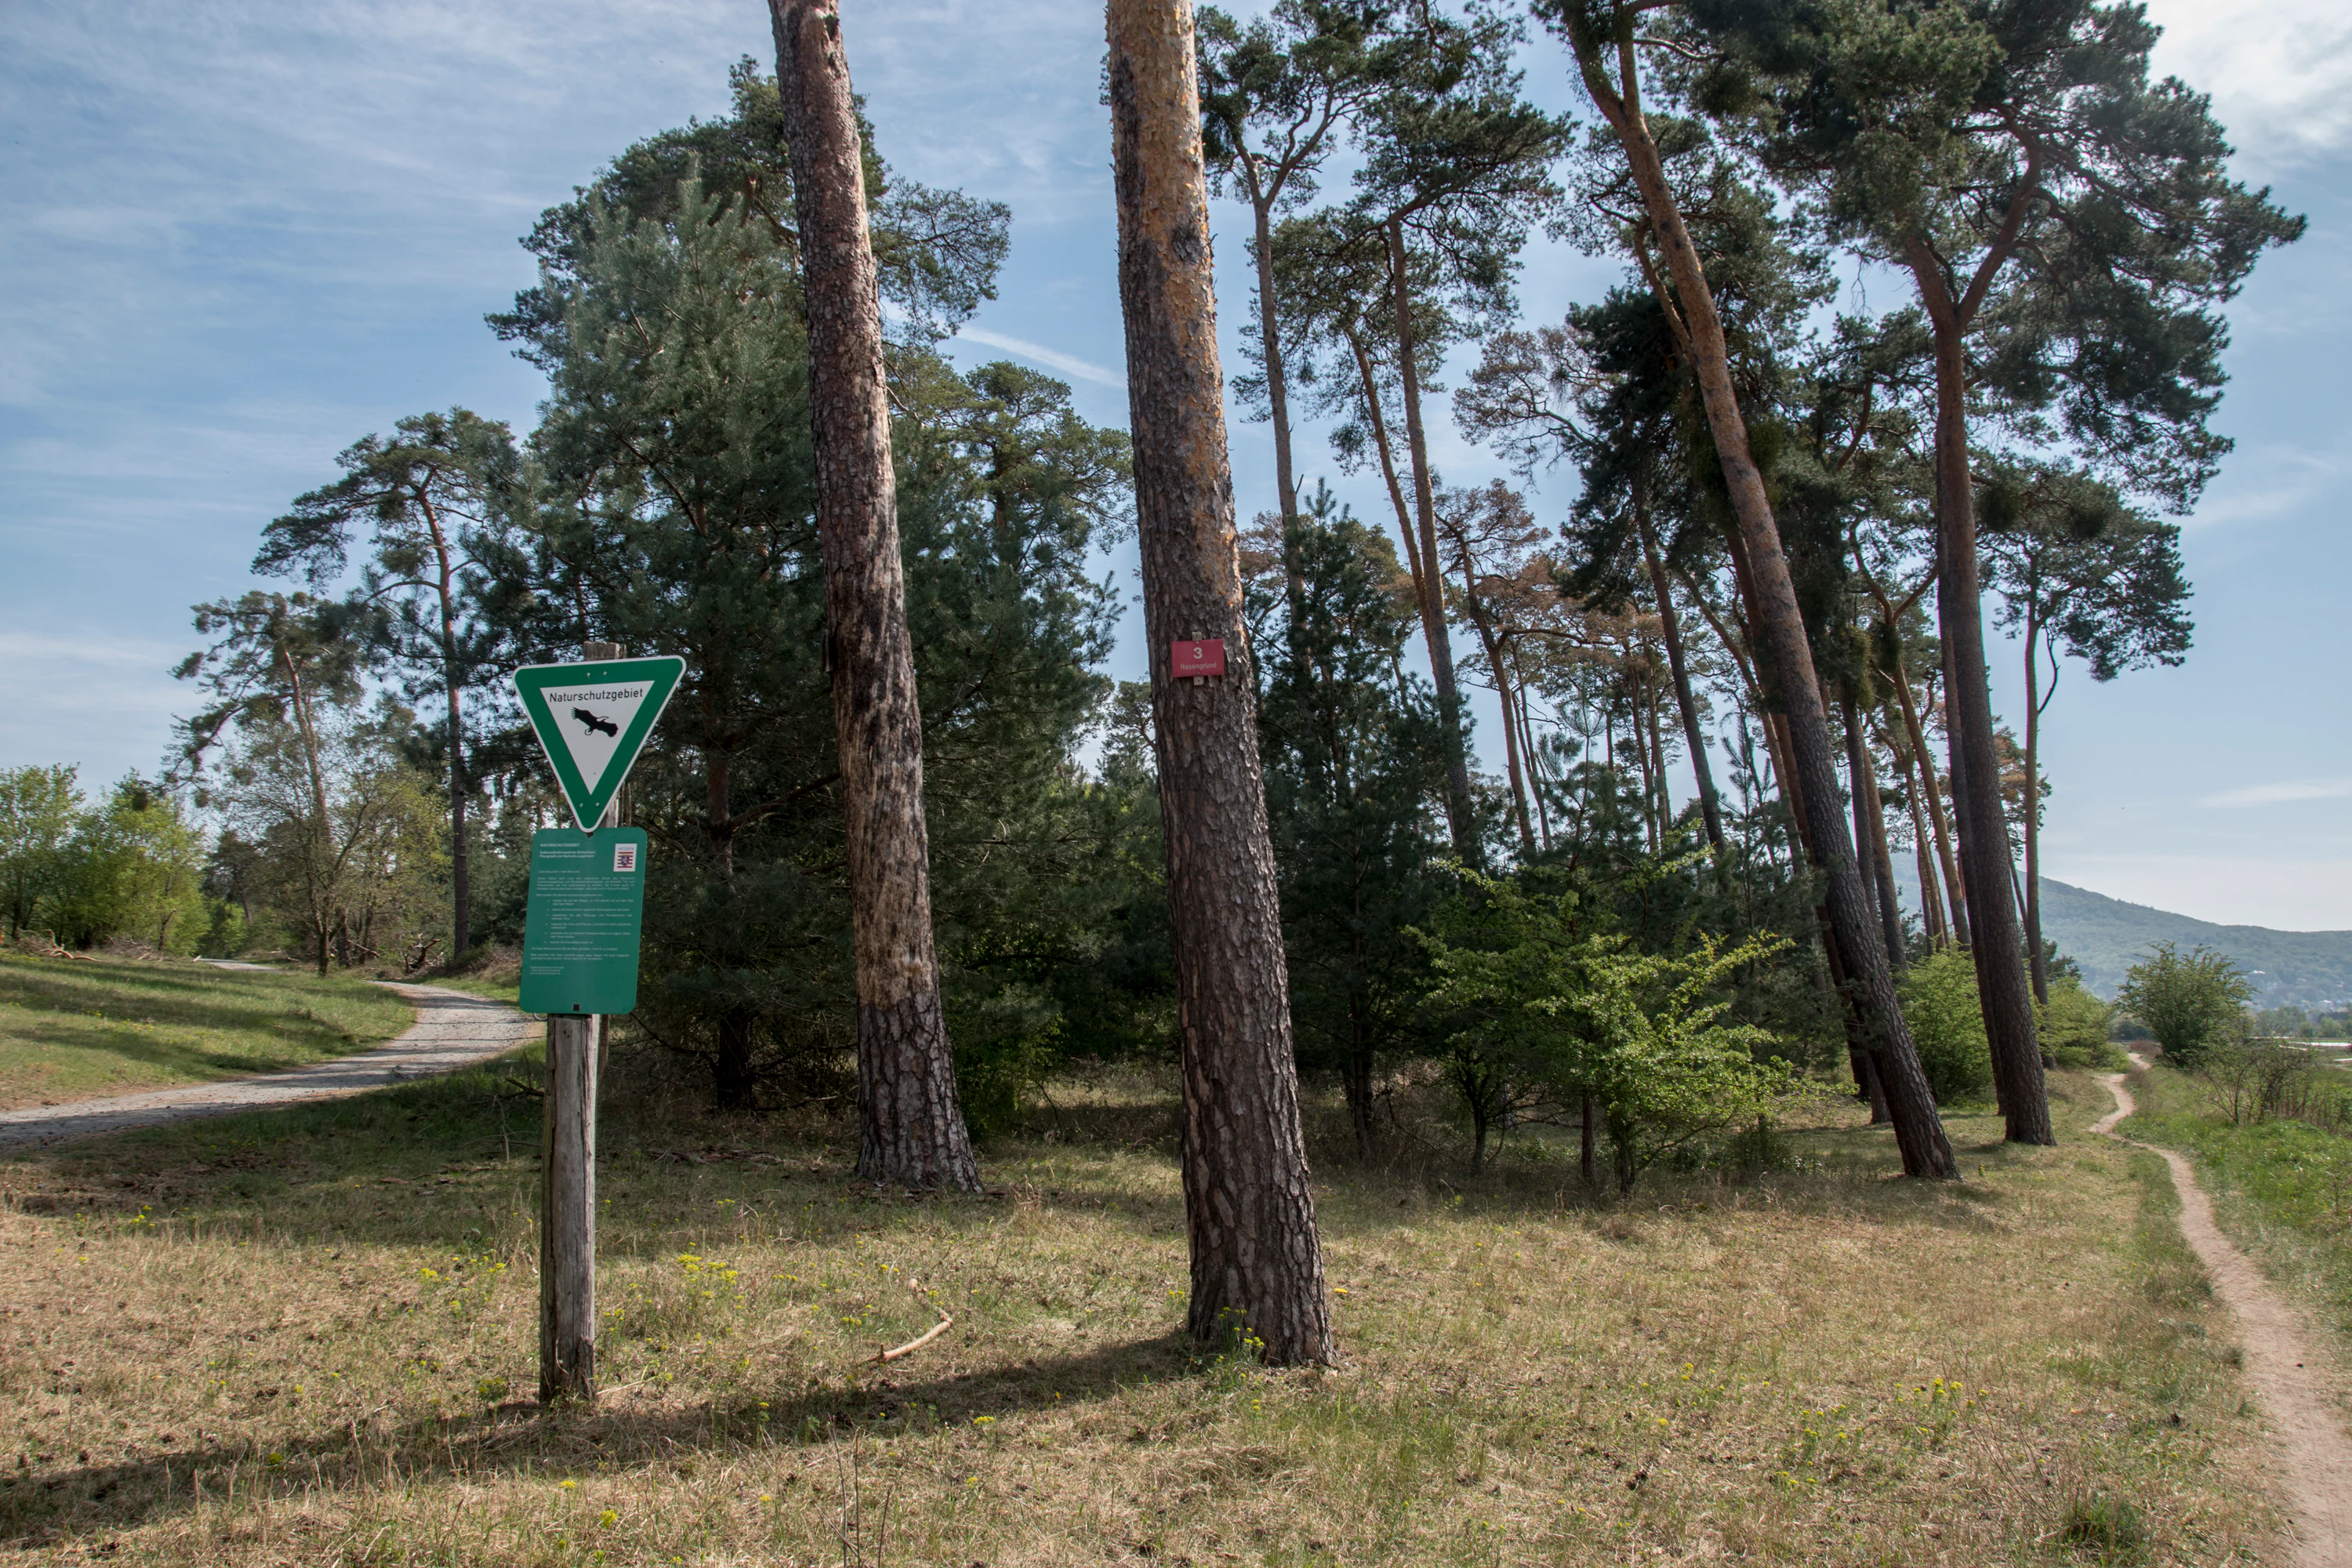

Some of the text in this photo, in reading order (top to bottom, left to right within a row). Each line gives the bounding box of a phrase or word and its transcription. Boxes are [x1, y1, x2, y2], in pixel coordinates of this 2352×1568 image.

[1193, 647, 1203, 659] 3
[1180, 662, 1217, 670] Hasengrund
[550, 688, 643, 702] Naturschutzgebiet
